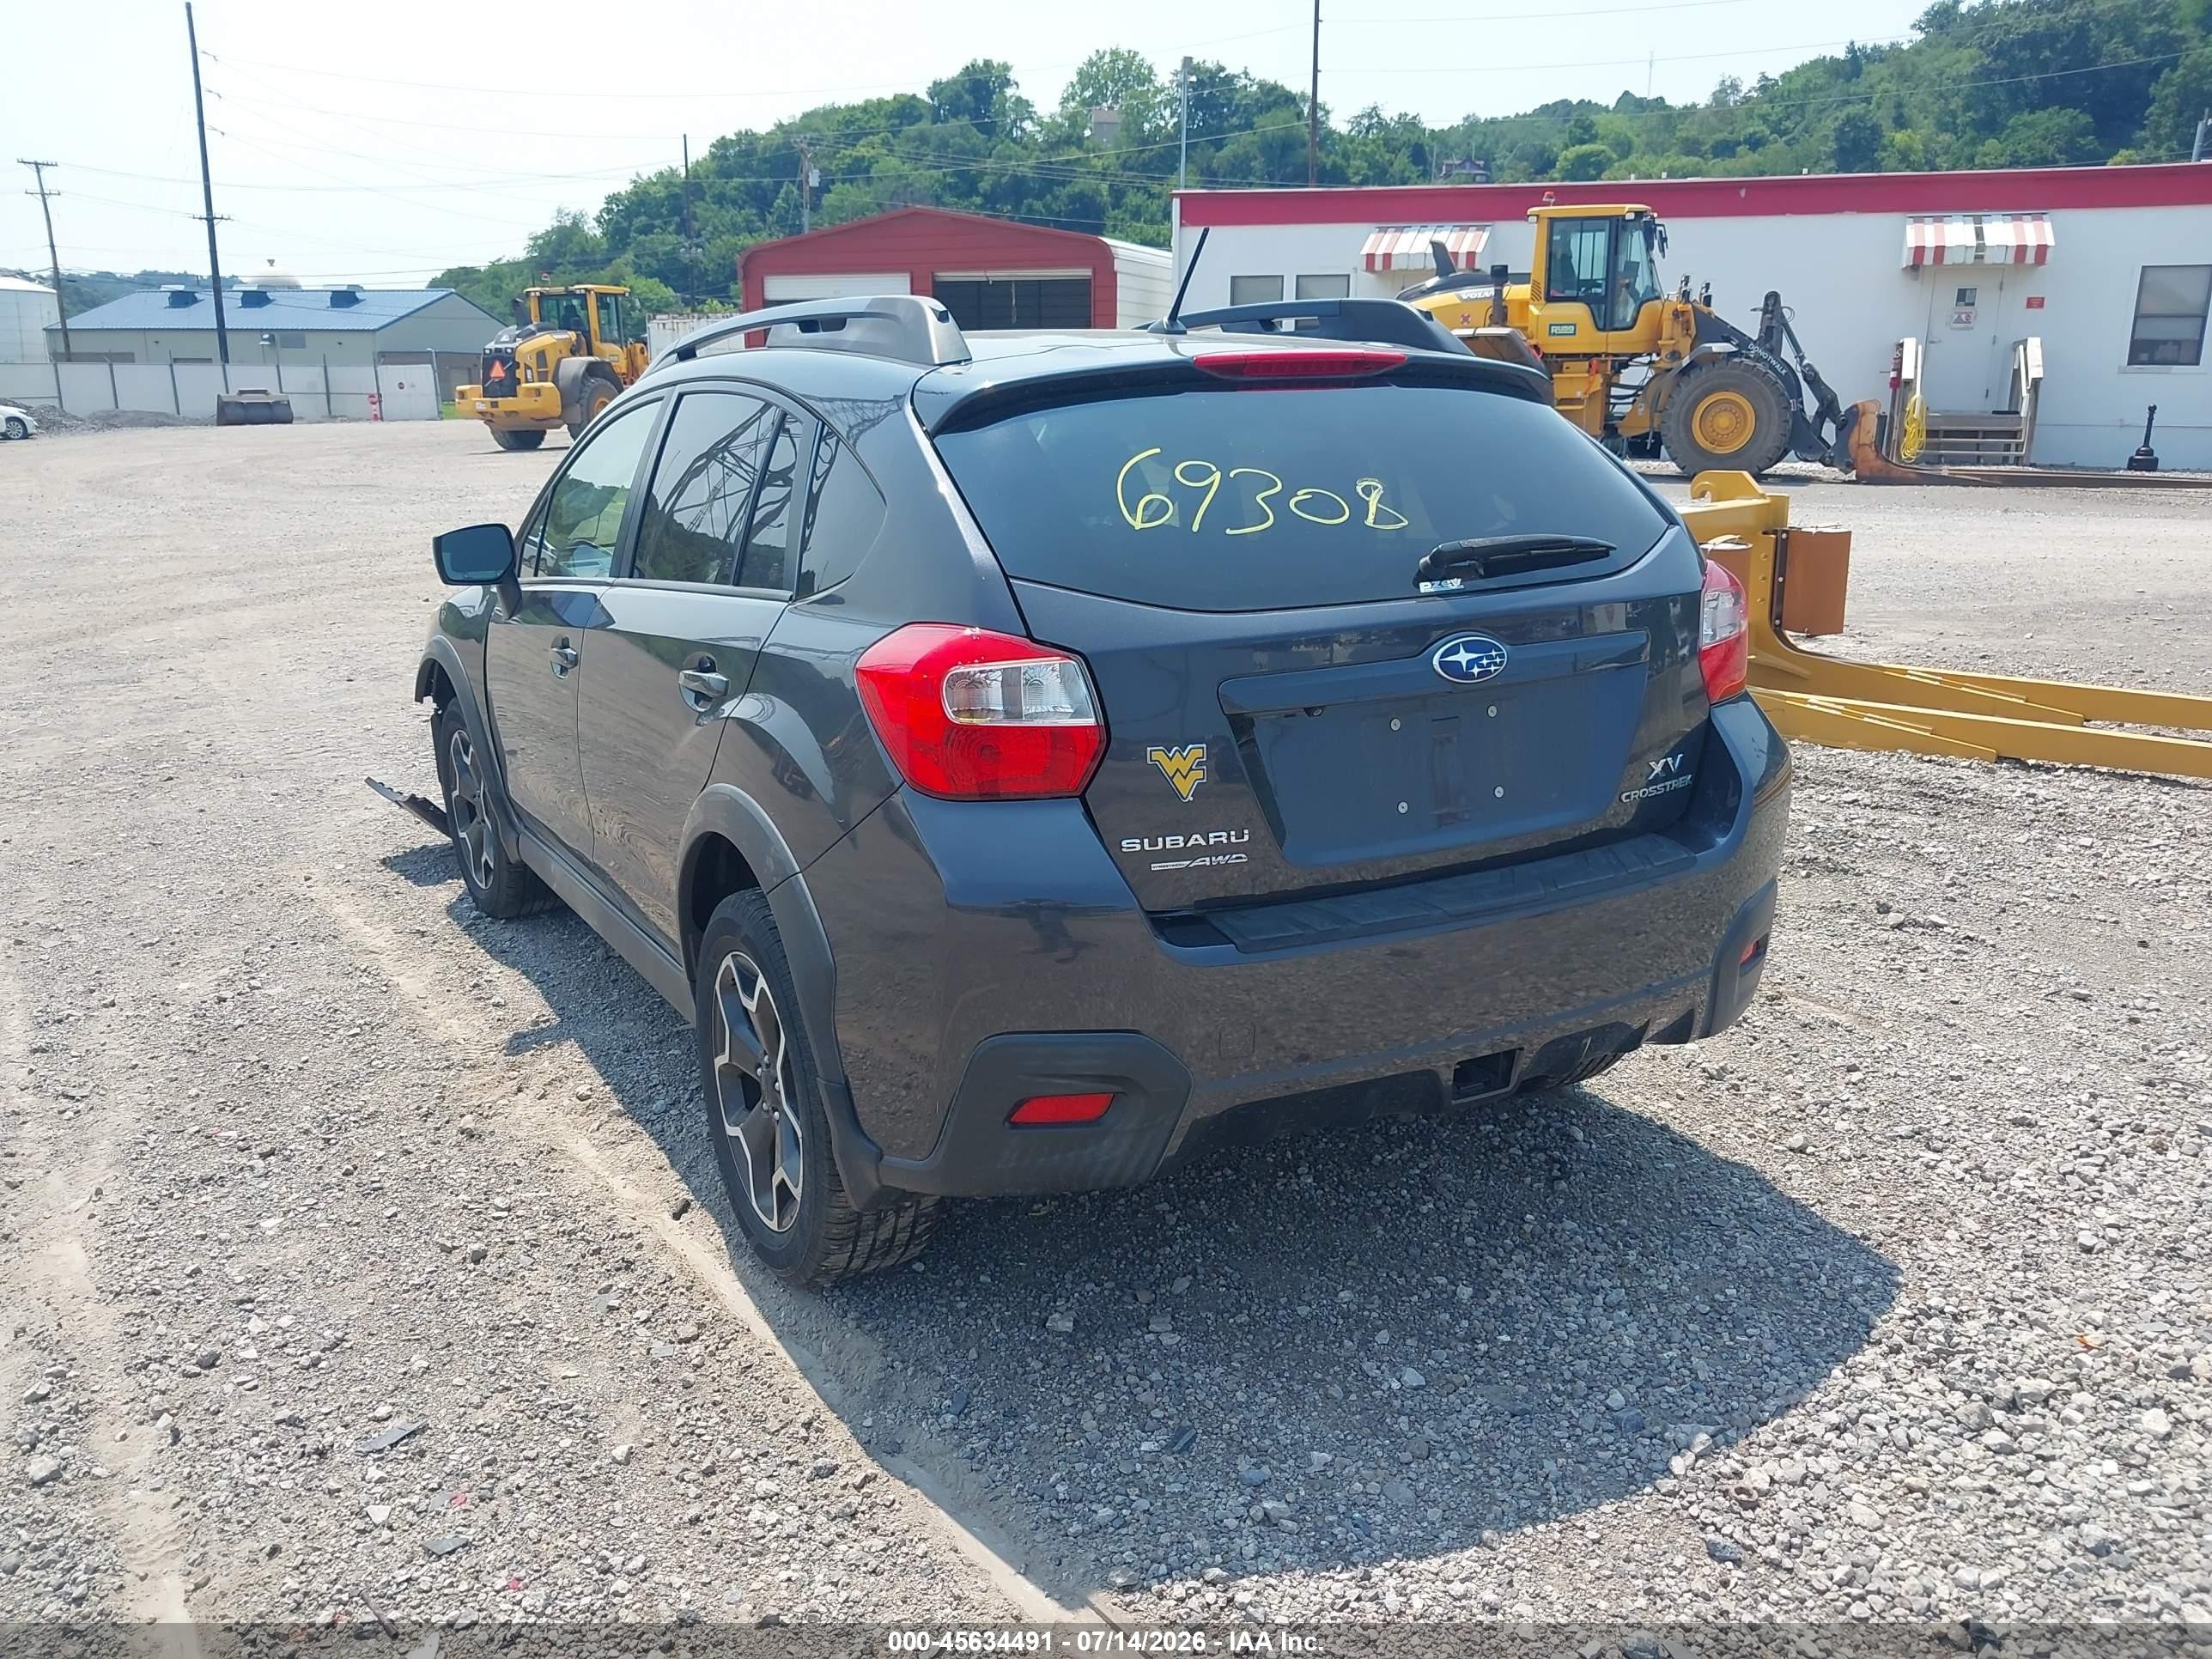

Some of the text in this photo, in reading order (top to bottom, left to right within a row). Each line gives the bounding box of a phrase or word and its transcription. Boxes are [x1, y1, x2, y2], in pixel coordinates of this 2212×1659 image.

[1460, 288, 1495, 301] VOLV
[1116, 447, 1409, 536] 69308
[1648, 754, 1683, 780] XV
[1620, 775, 1692, 803] CROSSTREK
[1121, 829, 1249, 853] SUBARU
[1188, 854, 1249, 867] AWD
